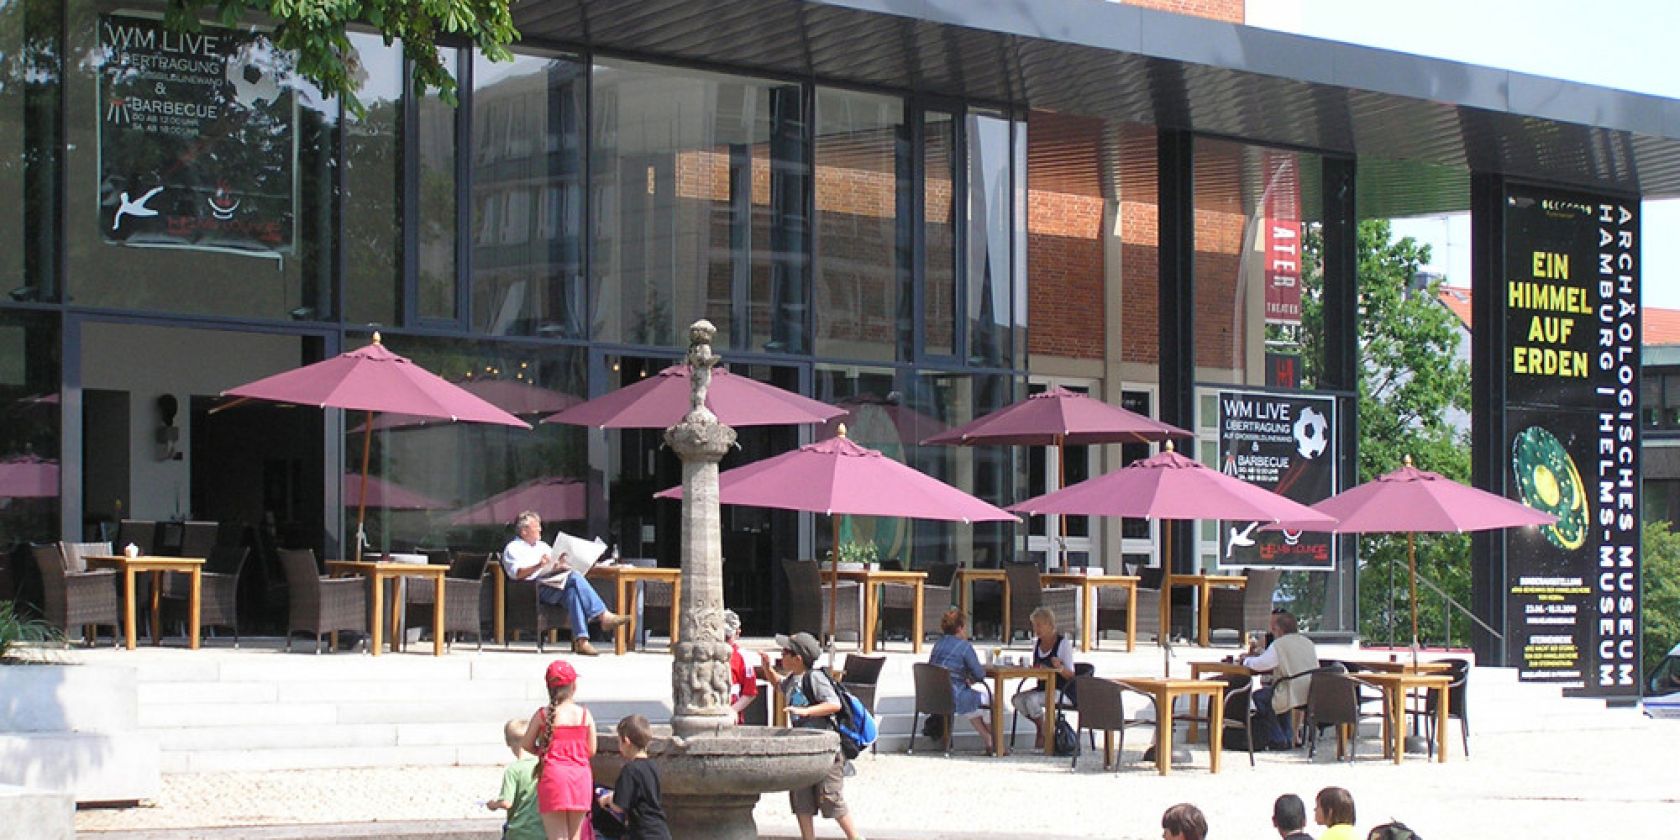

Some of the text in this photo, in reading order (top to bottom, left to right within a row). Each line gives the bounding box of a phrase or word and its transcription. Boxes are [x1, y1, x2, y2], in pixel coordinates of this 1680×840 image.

[105, 24, 219, 56] WM LIVE
[155, 82, 166, 94] &
[132, 97, 218, 119] BARBECUE
[1532, 251, 1569, 280] EIN
[1508, 281, 1593, 315] HIMMEL
[1599, 204, 1614, 371] HAMBURG
[1528, 315, 1575, 344] AUF
[1513, 347, 1589, 378] ERDEN
[1224, 400, 1291, 420] WM LIVE
[1226, 418, 1291, 434] ÜBERTRAGUNG
[1618, 205, 1635, 685] ARCHÄOLOGISCHES MUSEUM
[1237, 455, 1290, 467] BARBECUE
[1599, 413, 1614, 685] HELMS-MUSEUM
